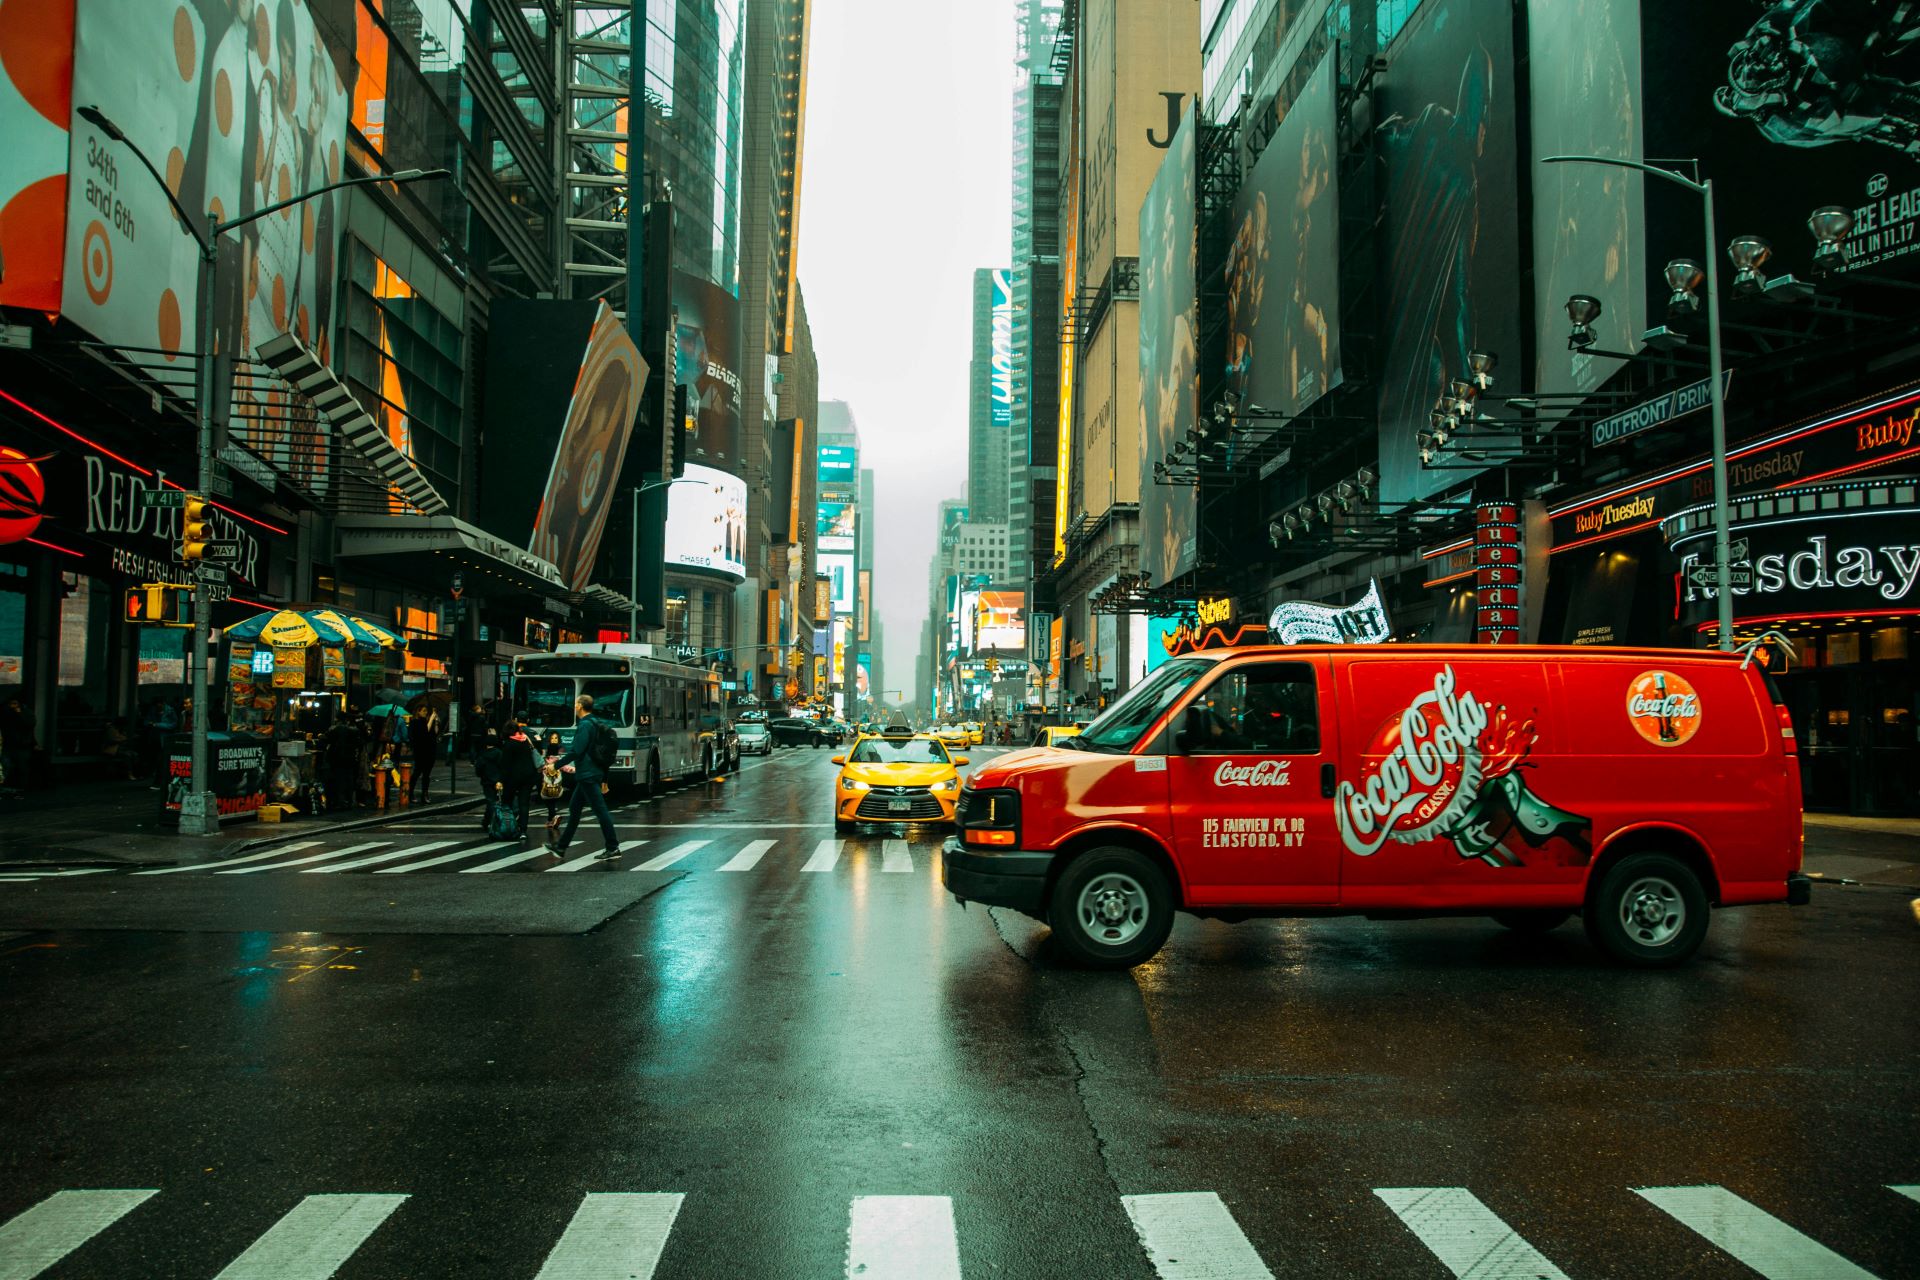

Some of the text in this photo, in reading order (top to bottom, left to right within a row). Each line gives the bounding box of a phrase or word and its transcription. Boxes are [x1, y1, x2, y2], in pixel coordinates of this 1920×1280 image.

[87, 136, 117, 190] 34th
[1867, 176, 1888, 195] DC
[86, 178, 134, 242] and 6th
[1869, 232, 1880, 253] IN
[1883, 222, 1915, 247] 11.17
[706, 361, 737, 388] BLADE
[1595, 381, 1713, 443] OUTFRONT PRIM
[1856, 416, 1914, 452] Ruby
[84, 455, 147, 534] RED
[145, 492, 154, 504] W
[159, 492, 173, 504] 41
[112, 547, 194, 585] FRESH FISH LIVE
[680, 555, 704, 564] CHASE
[1487, 507, 1503, 644] Tuesday
[1697, 572, 1717, 582] ONE
[271, 624, 306, 634] SABRETT
[272, 639, 308, 647] SABRETT
[668, 646, 697, 657] HAS
[1629, 693, 1697, 718] Coca-Cola
[218, 747, 262, 760] BROADWAY'S
[218, 759, 238, 771] SURE
[1334, 664, 1487, 856] Coca-Cola
[1214, 760, 1291, 787] Coca-Cola
[1418, 780, 1455, 818] CLASSIC
[1202, 818, 1305, 832] 115 FAIRVIEW PK DR
